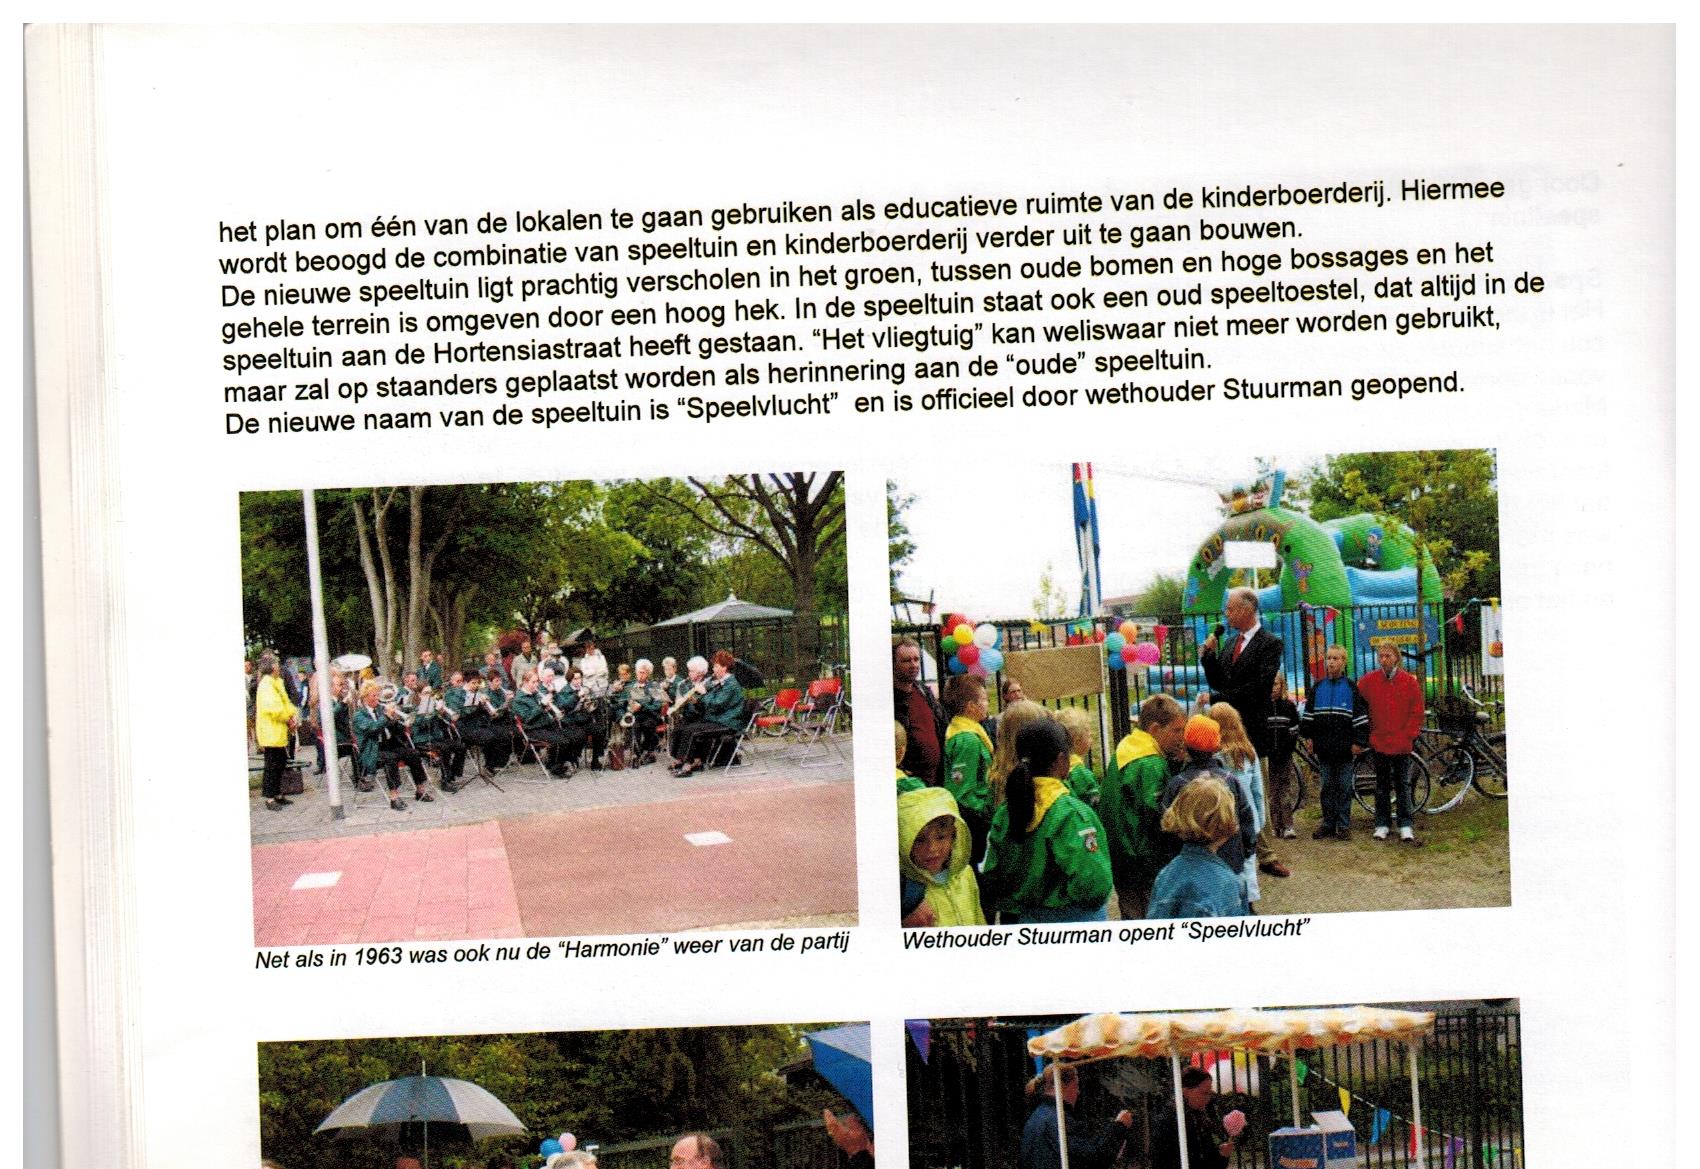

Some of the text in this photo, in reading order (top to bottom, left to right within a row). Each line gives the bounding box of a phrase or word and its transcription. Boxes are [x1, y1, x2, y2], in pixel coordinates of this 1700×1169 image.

[219, 220, 257, 243] het
[265, 219, 316, 247] plan
[324, 221, 362, 240] om
[371, 215, 416, 238] één
[423, 218, 468, 236] van
[477, 211, 508, 234] de
[516, 208, 602, 233] lokalen
[610, 208, 634, 230] te
[641, 209, 703, 234] gaan
[711, 201, 832, 232] gebruiken
[841, 198, 876, 222] als
[884, 194, 1018, 220] educatieve
[1026, 191, 1103, 215] ruimte
[1110, 193, 1155, 212] van
[1163, 187, 1194, 210] de
[1202, 180, 1391, 209] kinderboerderij.
[1401, 178, 1505, 201] Hiermee
[218, 218, 1302, 276] wordt beoogd de combinatie van speeltuin en kinderboerderij verder uit te gaan bouwen.
[221, 241, 1494, 307] De nieuwe speeltuin ligt prachtig verscholen in het groen, tussen oude bomen en hoge bossages en het
[223, 346, 333, 376] speeltuin
[341, 349, 387, 367] aan
[395, 343, 426, 365] de
[434, 336, 622, 364] Hortensiastraat
[629, 333, 692, 357] heeft
[698, 331, 803, 360] gestaan.
[992, 322, 1035, 344] kan
[1042, 319, 1166, 343] weliswaar
[1174, 315, 1219, 338] niet
[1226, 317, 1290, 336] meer
[1295, 309, 1387, 334] worden
[1395, 305, 1500, 336] gebruikt,
[226, 413, 260, 435] De
[268, 411, 355, 434] nieuwe
[364, 411, 432, 430] naam
[439, 409, 484, 428] van
[492, 403, 524, 426] de
[531, 399, 641, 429] speeltuin
[650, 398, 670, 420] is
[854, 395, 884, 413] en
[893, 389, 913, 412] is
[921, 385, 1014, 411] officieel
[1022, 385, 1079, 408] door
[1084, 379, 1216, 405] wethouder
[1223, 377, 1342, 400] Stuurman
[1351, 370, 1464, 401] geopend.
[255, 950, 290, 969] Net
[295, 949, 324, 968] als
[330, 952, 347, 967] in
[355, 946, 403, 966] 1963
[409, 949, 448, 964] was
[453, 943, 491, 963] ook
[495, 946, 521, 961] nu
[526, 941, 551, 960] de
[673, 939, 724, 955] weer
[729, 938, 764, 953] van
[770, 933, 795, 952] de
[800, 931, 850, 955] partij
[902, 930, 1012, 950] Wethouder
[1017, 926, 1112, 946] Stuurman
[1118, 924, 1175, 945] opent
